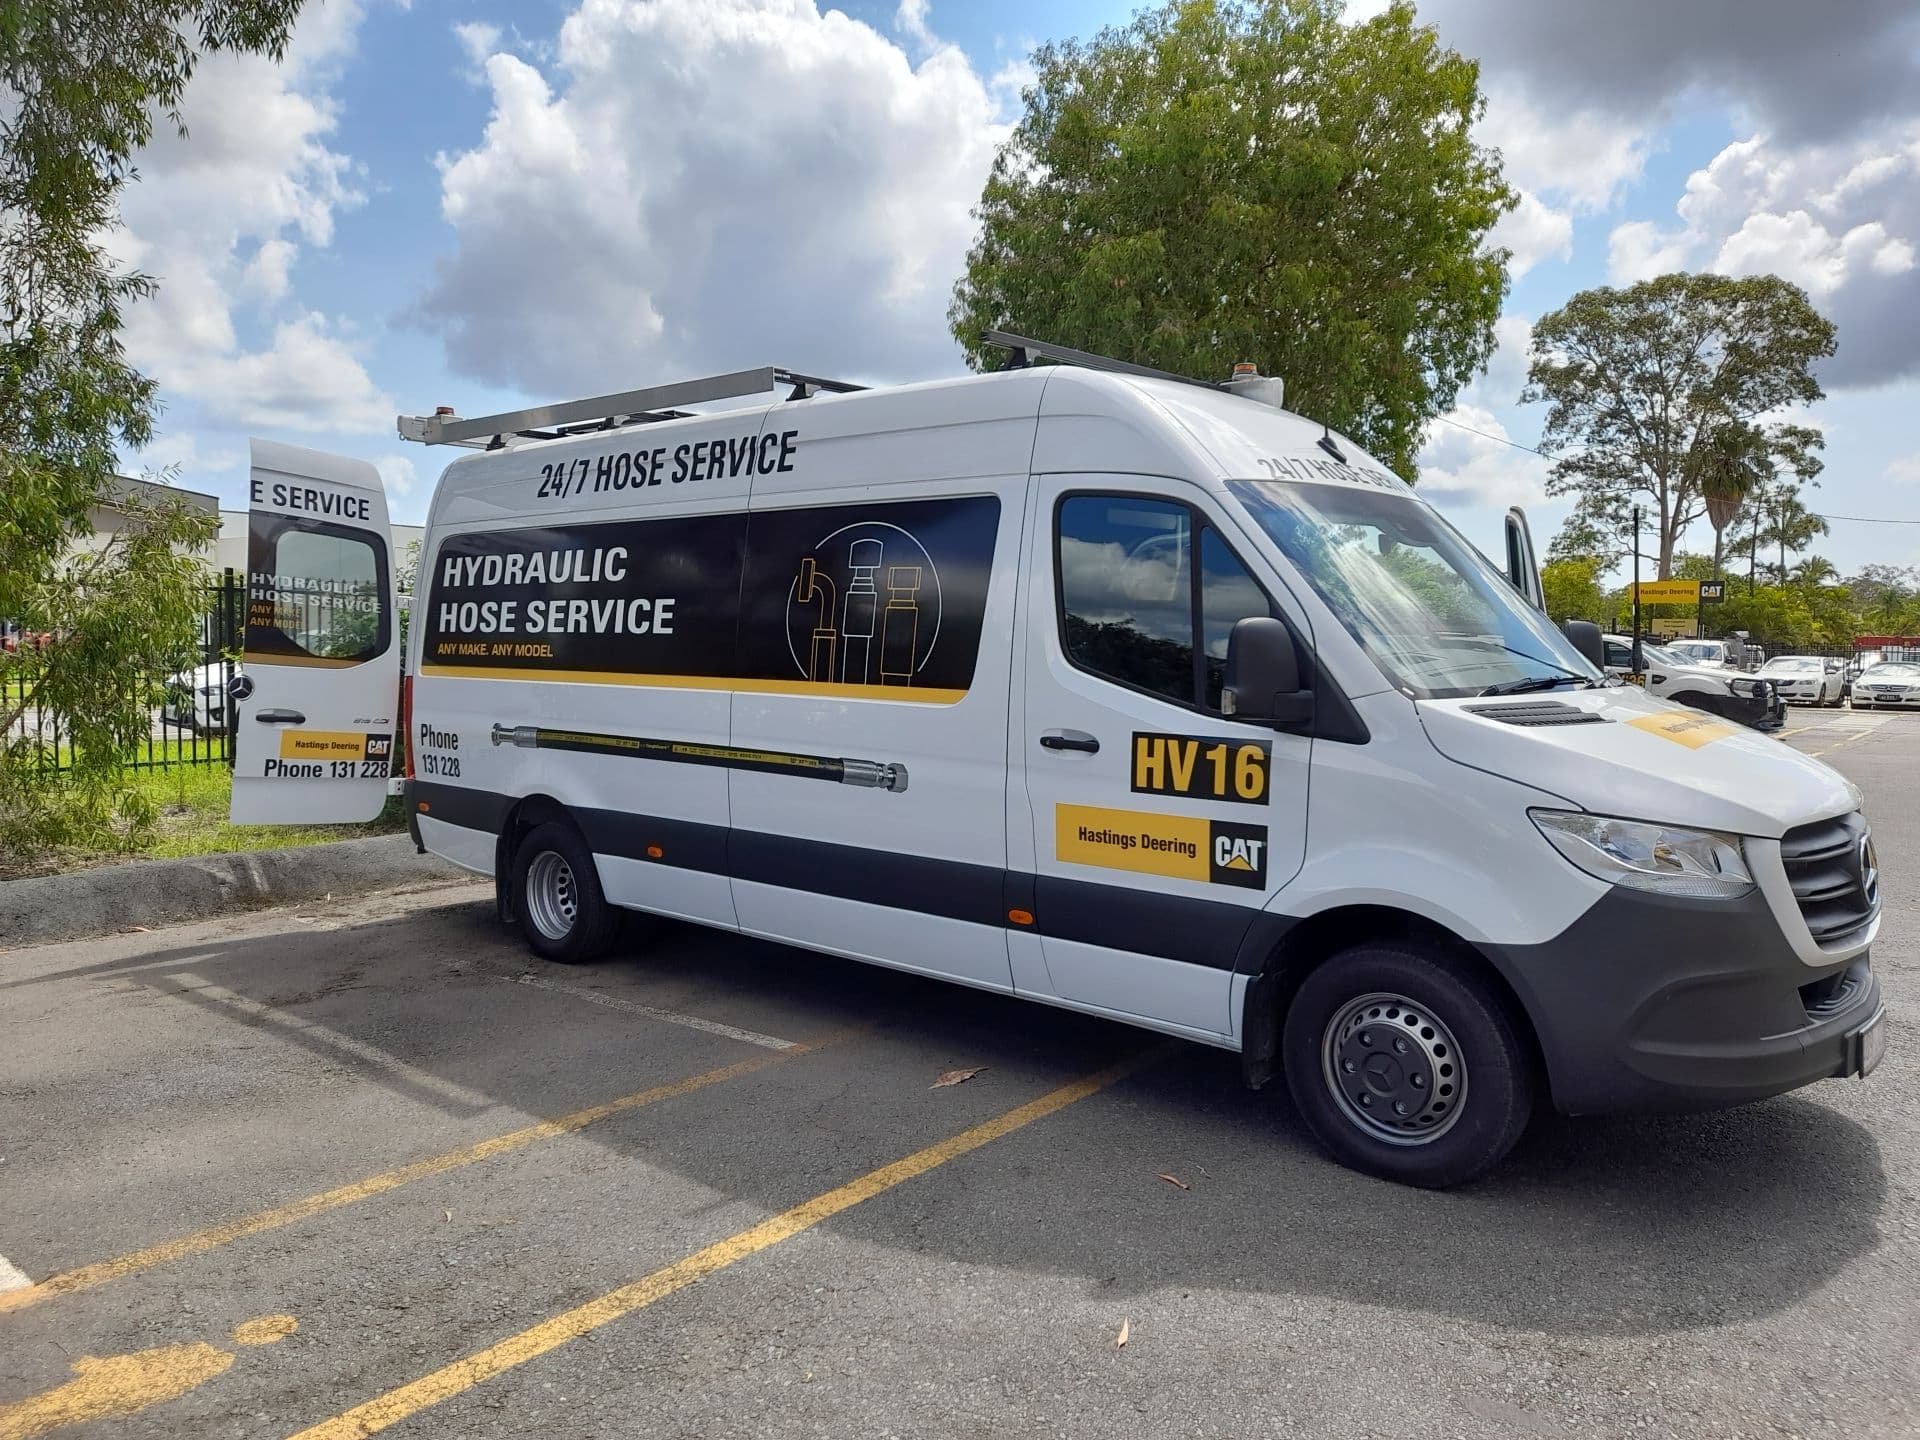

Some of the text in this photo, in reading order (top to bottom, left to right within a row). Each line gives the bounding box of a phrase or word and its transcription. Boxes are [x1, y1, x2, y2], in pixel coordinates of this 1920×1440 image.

[537, 430, 798, 498] 24/7 HOSE SERVICE
[1257, 457, 1314, 481] 24/7
[272, 483, 370, 521] SERVICE
[442, 546, 628, 587] HYDRAULIC
[251, 572, 360, 596] HYDRAULIC
[1640, 588, 1695, 596] Hastings Deering
[1701, 585, 1722, 597] CAT
[250, 588, 382, 614] HOSE SERVICE
[250, 604, 272, 614] ANY
[249, 617, 271, 627] ANY
[438, 598, 676, 635] HOSE SERVICE
[437, 643, 457, 655] ANY
[491, 644, 513, 656] ANY
[514, 644, 554, 657] MODEL
[295, 740, 360, 751] Hastings Deering
[367, 740, 390, 754] CAT
[421, 723, 459, 750] Phone
[264, 759, 389, 778] Phone 131 228
[422, 754, 461, 777] 131 228
[1136, 737, 1265, 799] HV 16
[1078, 826, 1197, 858] Hastings Deering
[1215, 836, 1263, 872] CAT
